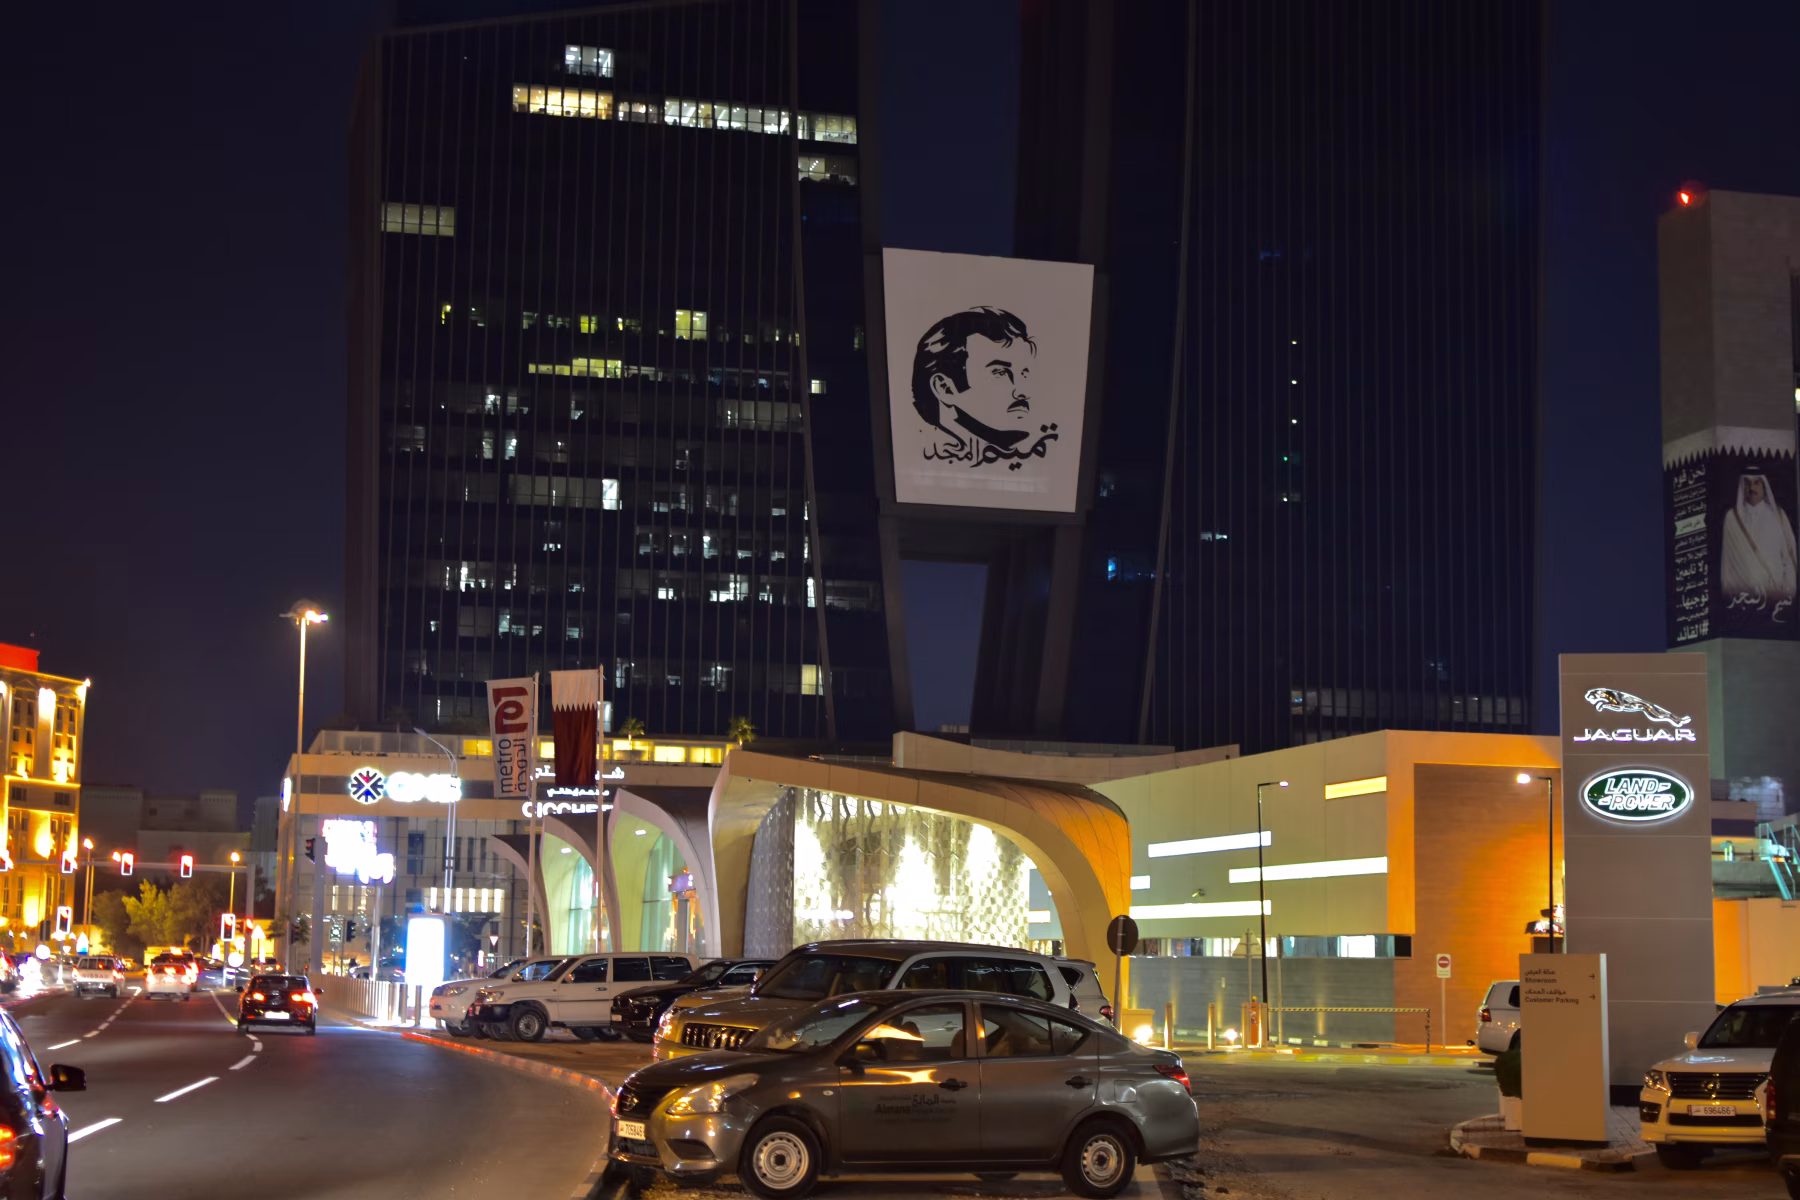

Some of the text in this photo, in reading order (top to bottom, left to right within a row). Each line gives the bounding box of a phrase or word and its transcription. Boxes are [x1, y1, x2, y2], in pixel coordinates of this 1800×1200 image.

[923, 422, 1059, 471] تميم المجد
[1573, 728, 1697, 742] JAGUAR
[497, 738, 514, 794] metro
[513, 738, 528, 793] الدوحة
[1605, 778, 1659, 794] LAND
[1609, 793, 1675, 811] ROVER
[1555, 997, 1579, 1005] Parking
